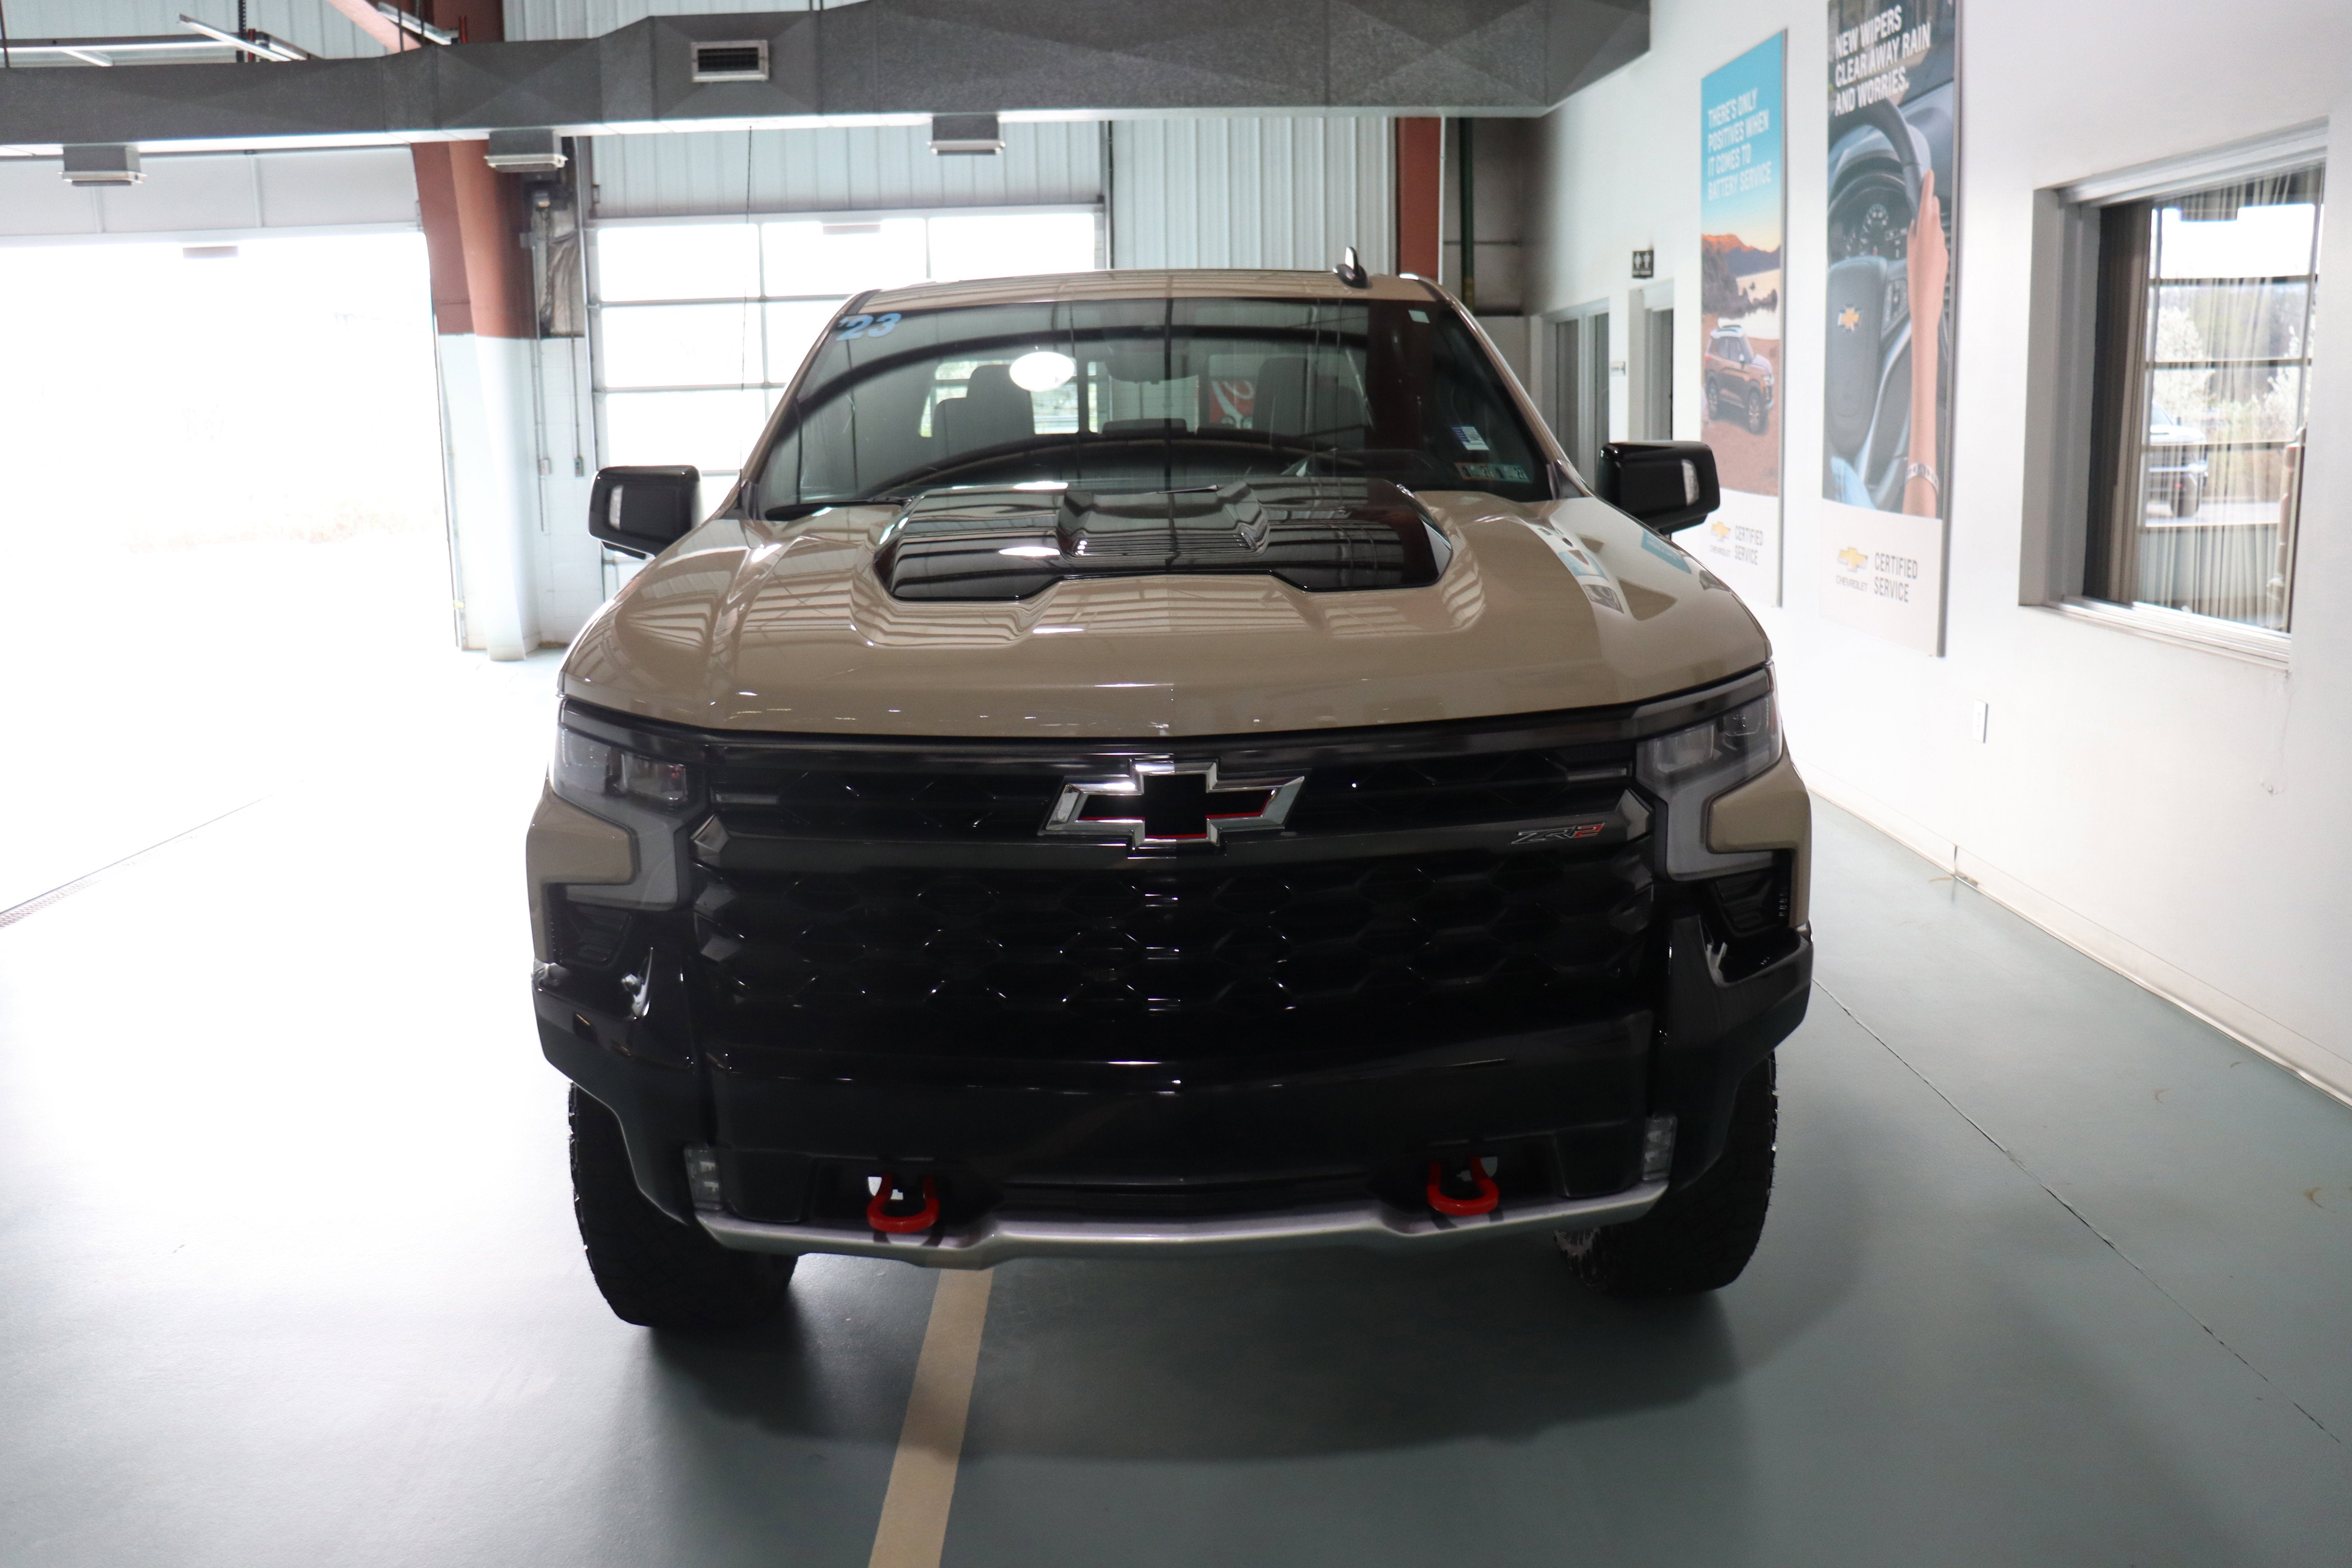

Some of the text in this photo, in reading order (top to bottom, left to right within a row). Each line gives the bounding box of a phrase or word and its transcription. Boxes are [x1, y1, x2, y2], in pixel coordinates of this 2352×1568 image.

[1836, 4, 1902, 60] NEW WIPERS
[1835, 21, 1931, 87] CLEAR AWAY RAIN
[1708, 87, 1758, 129] THERE'S ONLY
[1835, 66, 1910, 116] AND WORRIES.
[1708, 109, 1769, 153] POSITIVES WHEN
[1708, 143, 1751, 177] IT COMES TO
[1708, 161, 1772, 201] BATTERY SERVICE
[1735, 526, 1763, 546] CERTIFIED
[1735, 545, 1757, 565] SERVICE
[1875, 552, 1918, 579] CERTIFIED
[1836, 575, 1868, 591] CHEVROLET
[1874, 576, 1909, 603] SERVICE
[1511, 821, 1606, 844] ZR2
